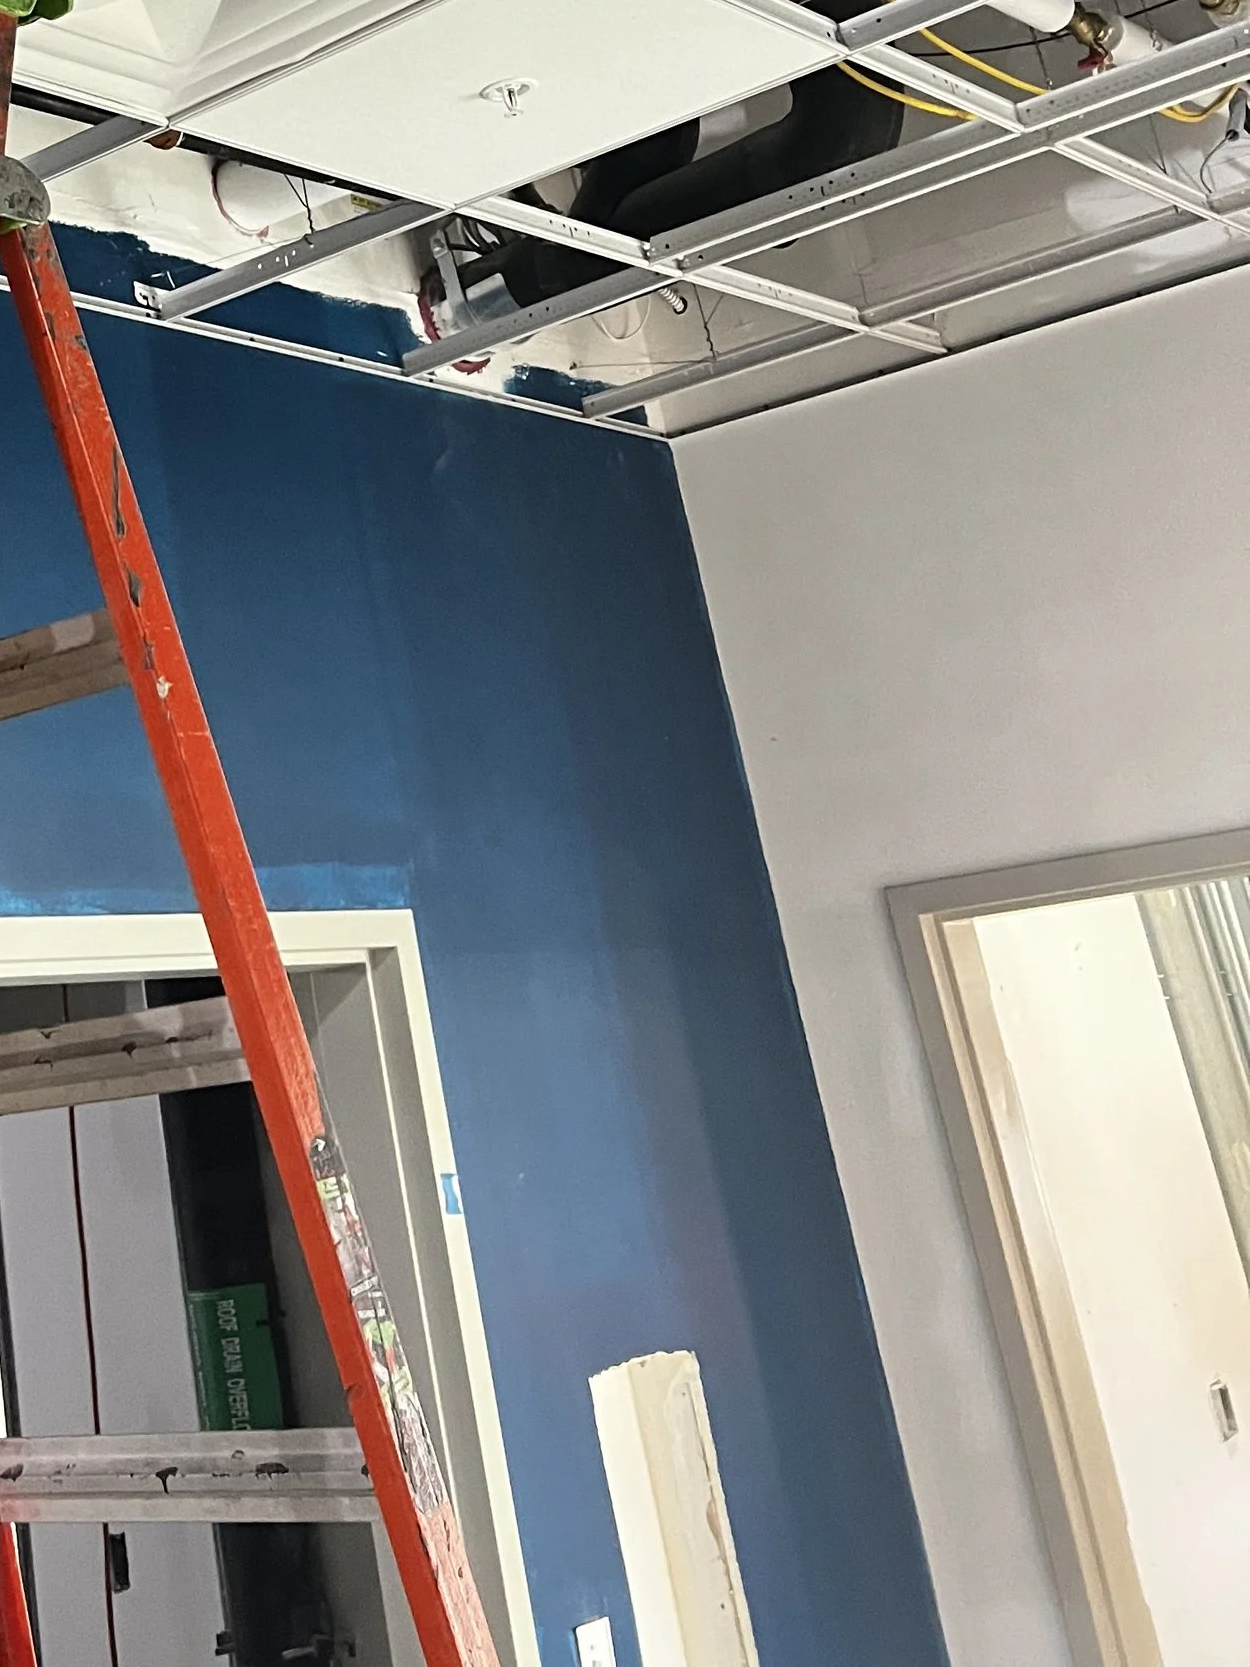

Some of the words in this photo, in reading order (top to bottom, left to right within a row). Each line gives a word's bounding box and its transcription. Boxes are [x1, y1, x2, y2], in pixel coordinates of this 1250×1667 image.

[216, 1298, 238, 1331] ROOF
[221, 1337, 243, 1373] DRAIN
[227, 1378, 252, 1430] OVERFLO
